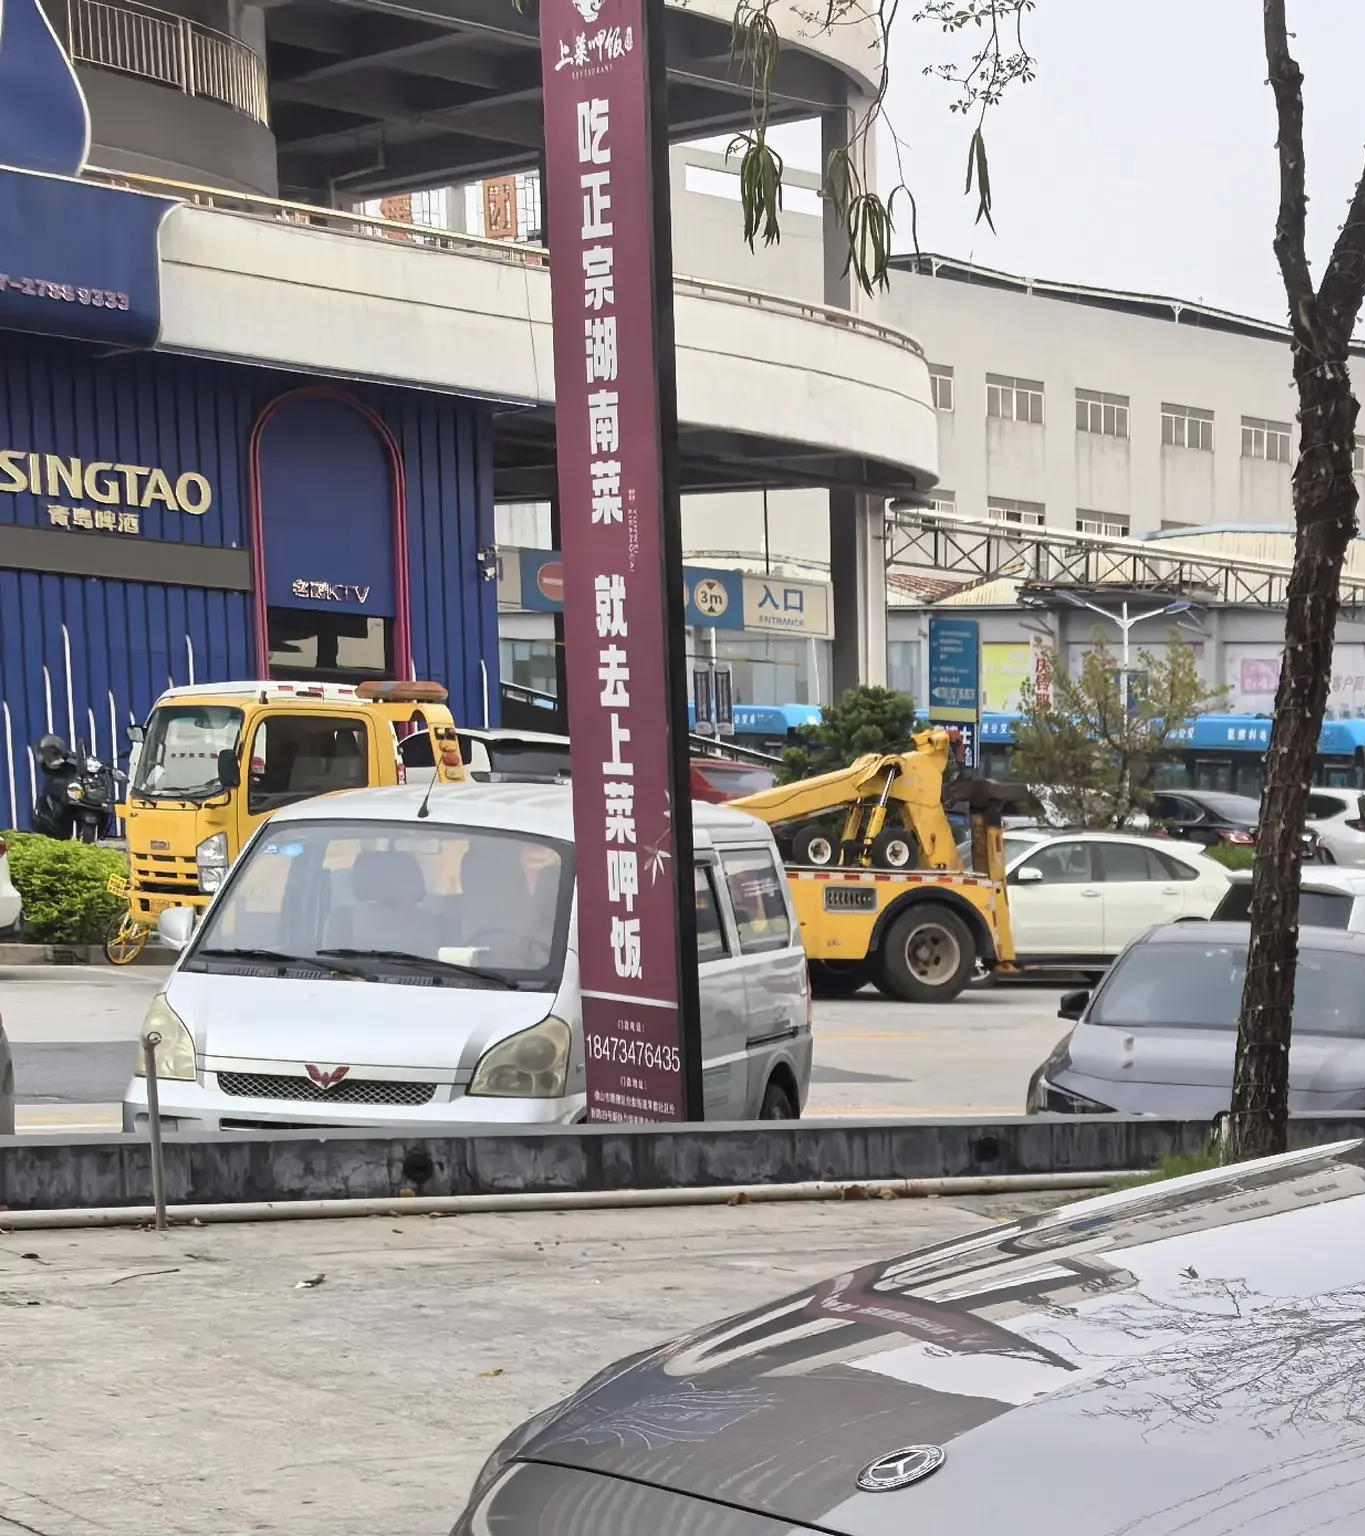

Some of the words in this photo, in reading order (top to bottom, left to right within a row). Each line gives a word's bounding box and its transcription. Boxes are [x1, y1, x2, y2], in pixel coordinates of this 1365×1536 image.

[577, 98, 624, 525] 吃正宗湖南菜
[0, 450, 212, 515] SINGTAO
[47, 504, 140, 535] 青岛啤酒
[700, 591, 722, 605] 3m
[758, 584, 804, 613] 入口
[595, 574, 643, 980] 就去上菜呷饭
[587, 1034, 681, 1072] 18473476435
